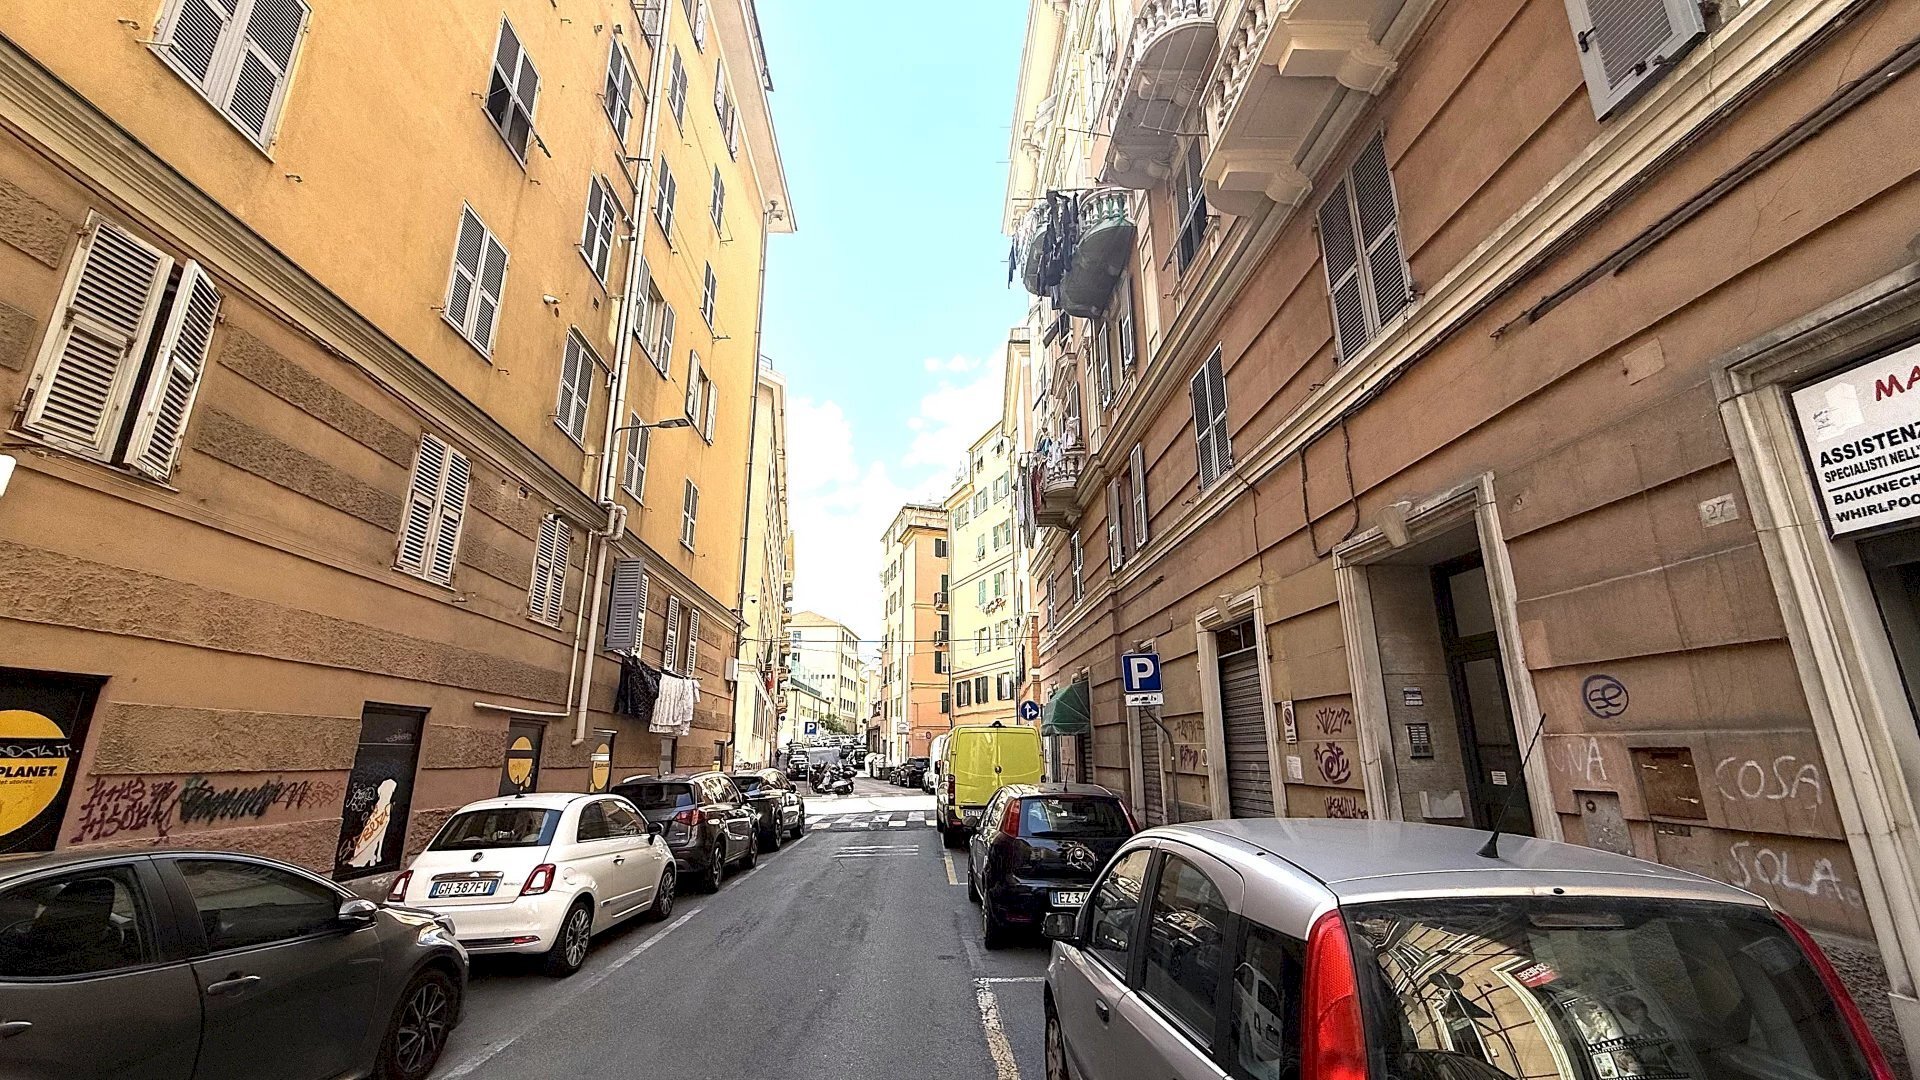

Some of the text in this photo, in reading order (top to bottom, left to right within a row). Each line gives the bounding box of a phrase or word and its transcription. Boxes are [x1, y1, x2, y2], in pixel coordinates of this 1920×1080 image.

[1825, 455, 1888, 483] SPECIALISTI
[1833, 473, 1920, 505] BAUKNECH
[1705, 500, 1727, 520] 27
[1836, 493, 1920, 523] WHIRLPOO
[1130, 657, 1155, 689] P
[806, 722, 816, 733] P
[1715, 755, 1823, 805] COSA
[1728, 840, 1844, 900] SOLA
